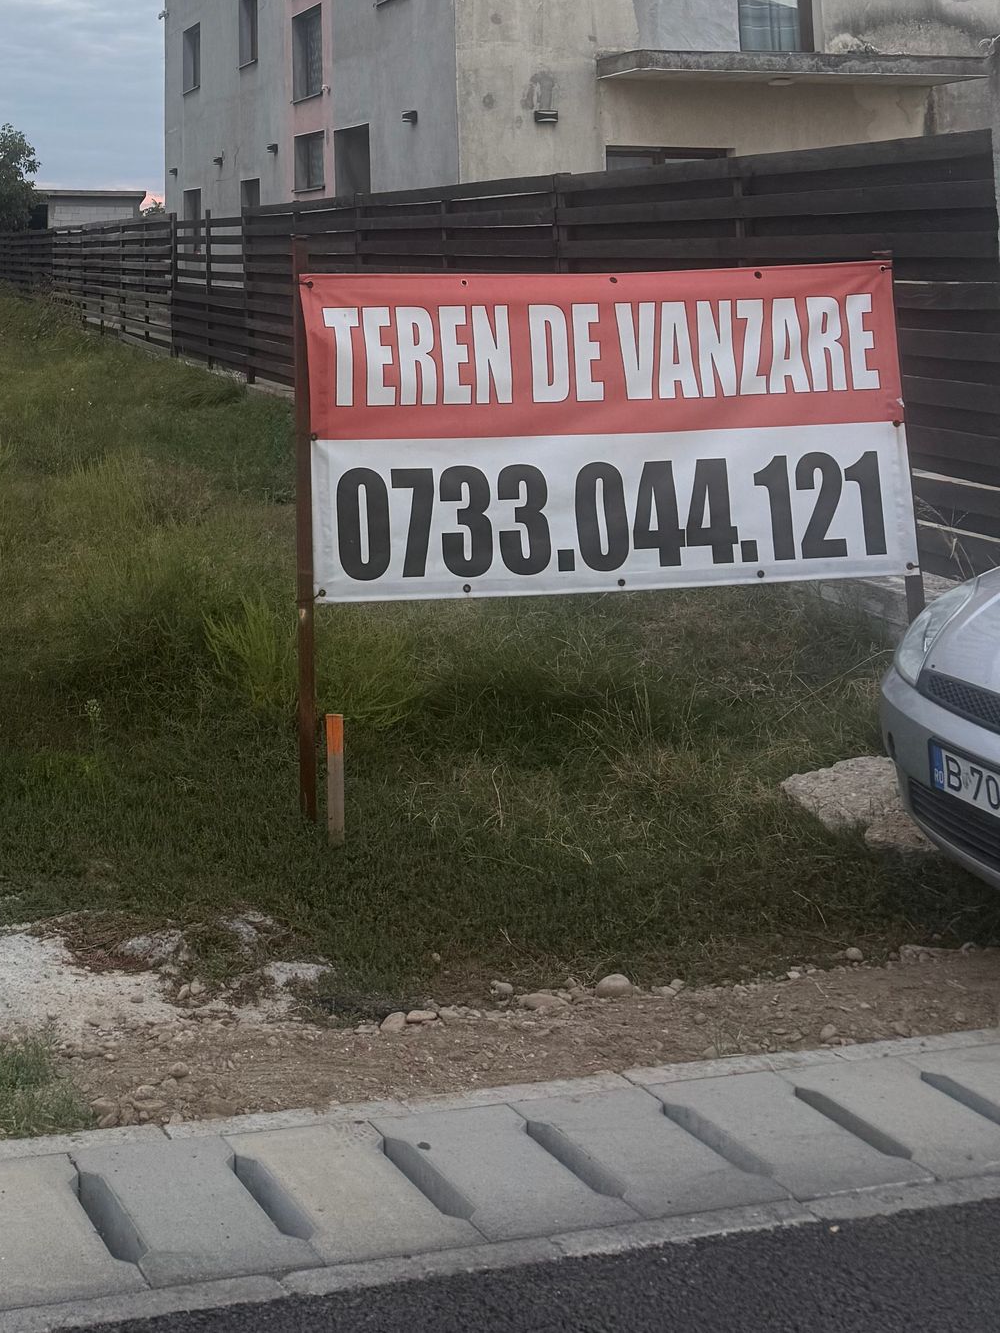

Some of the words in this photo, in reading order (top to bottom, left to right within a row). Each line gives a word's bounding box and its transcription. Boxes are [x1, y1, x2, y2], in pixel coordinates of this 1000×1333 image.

[323, 304, 513, 407] TEREN
[528, 302, 605, 403] DE
[614, 293, 882, 401] VANZARE
[336, 450, 888, 581] 0733.044.121
[945, 754, 963, 792] B
